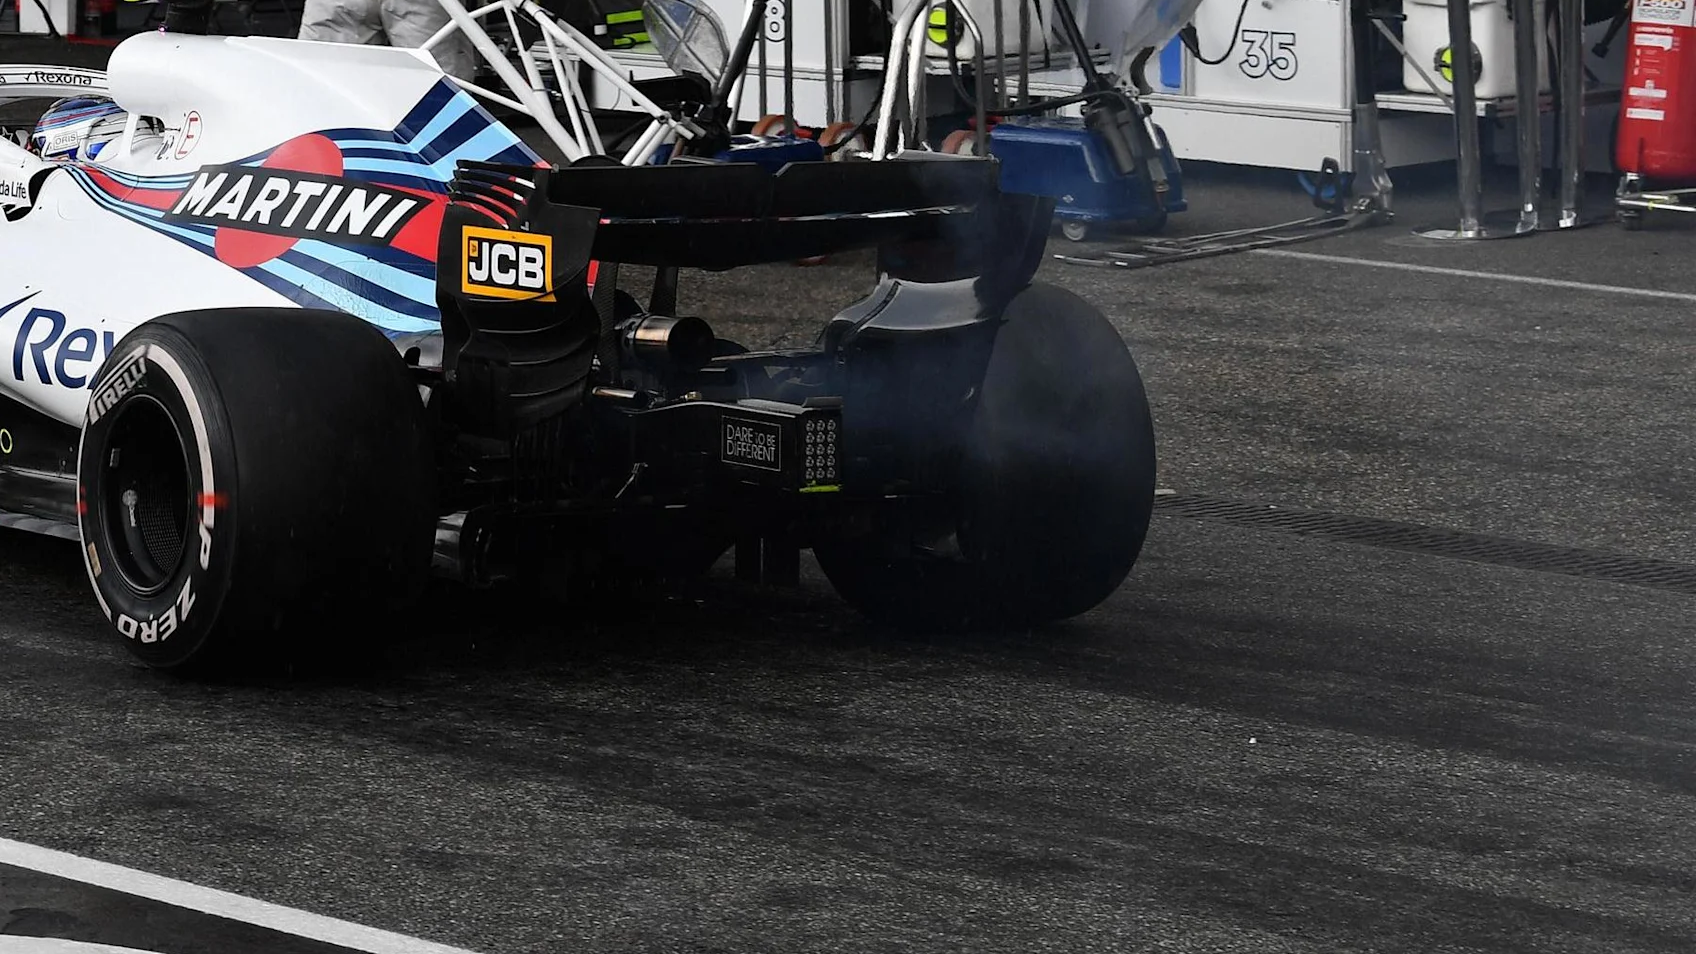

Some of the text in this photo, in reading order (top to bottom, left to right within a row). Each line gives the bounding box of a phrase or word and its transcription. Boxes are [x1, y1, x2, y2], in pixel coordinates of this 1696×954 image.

[1238, 30, 1298, 80] 35
[35, 71, 92, 86] Rexona
[54, 130, 77, 147] ORIS
[11, 181, 27, 199] Life
[172, 172, 417, 239] MARTINI
[469, 241, 544, 289] JCB
[88, 346, 148, 426] PIRELLI
[726, 423, 753, 443] DARE
[766, 434, 777, 446] BE
[726, 439, 777, 463] DIFFERENT
[116, 575, 195, 643] ZERO
